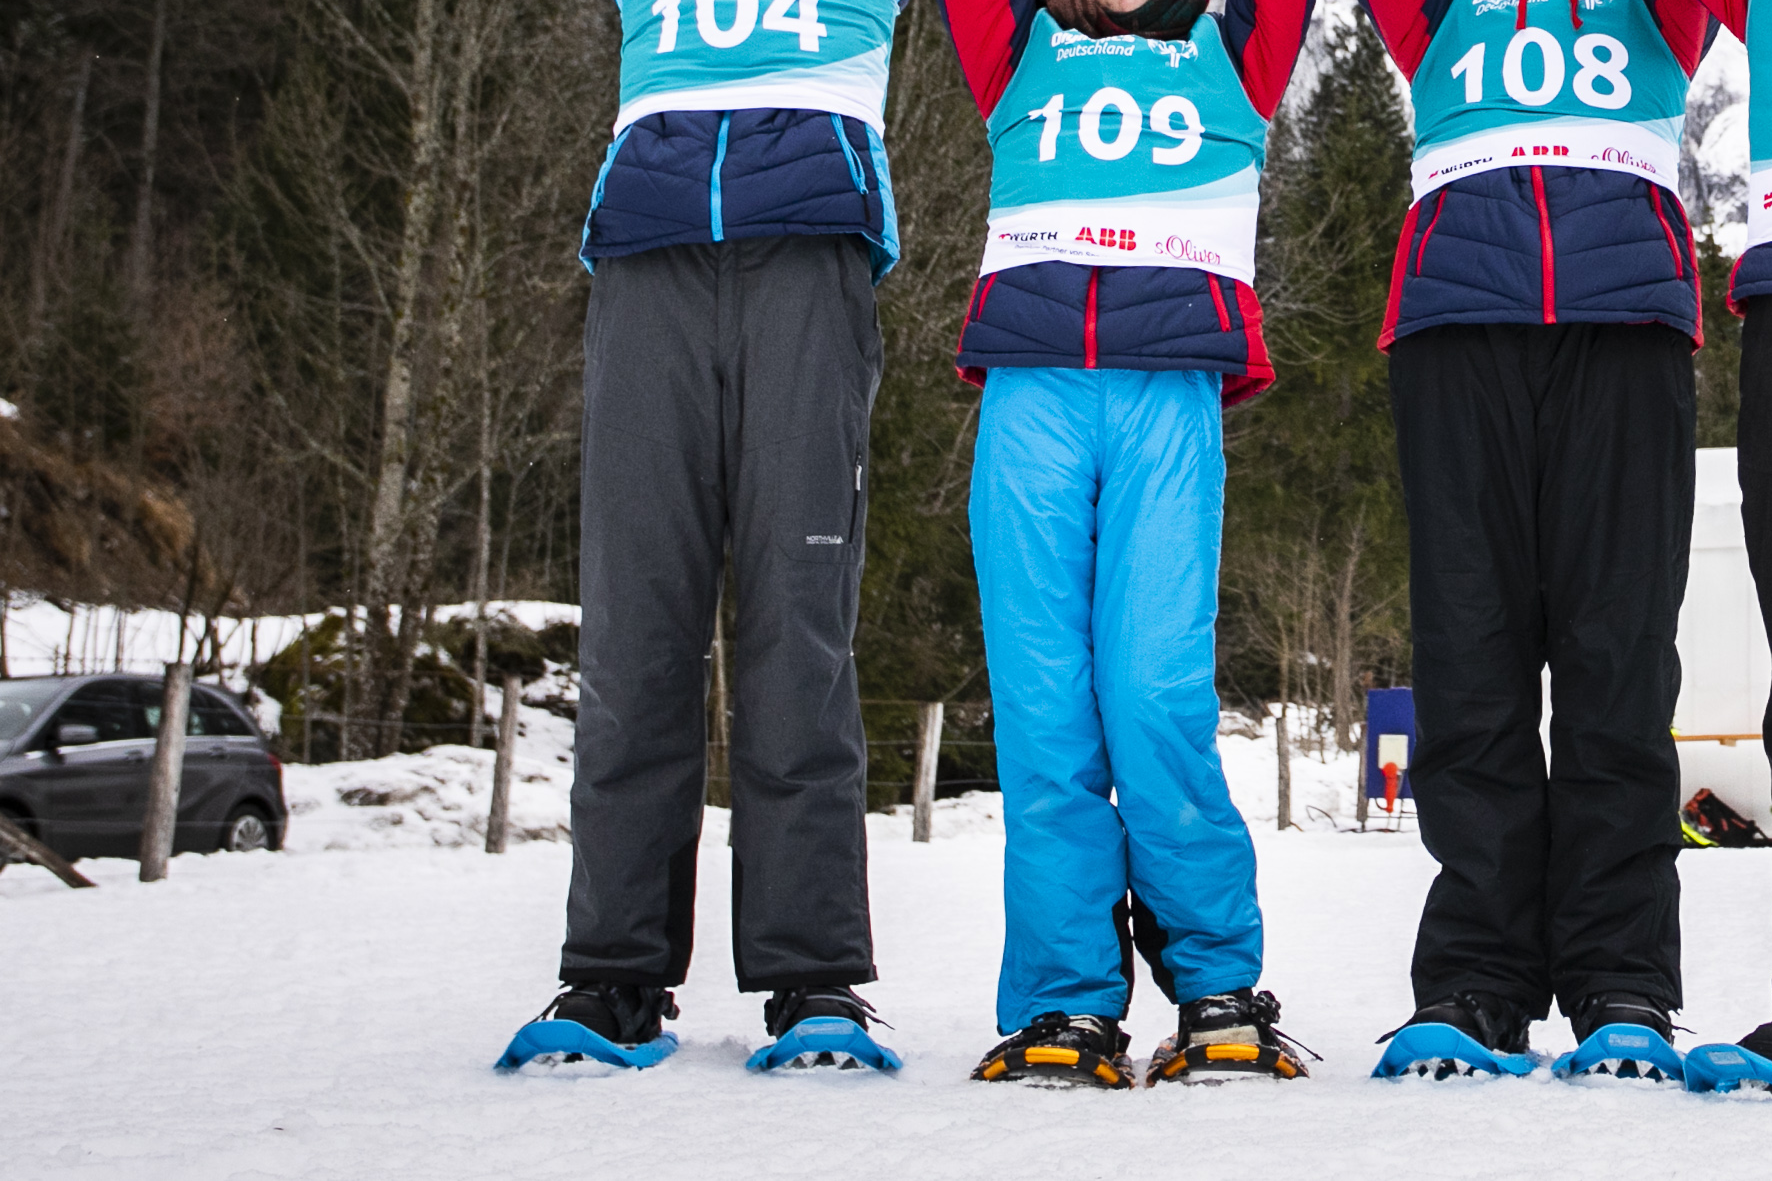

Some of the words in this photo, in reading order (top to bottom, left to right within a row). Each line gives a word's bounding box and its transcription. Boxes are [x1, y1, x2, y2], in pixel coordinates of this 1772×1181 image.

[1056, 40, 1136, 62] Deutschland
[1450, 27, 1632, 110] 108
[1027, 87, 1206, 166] 109
[1074, 226, 1137, 251] ABB
[1154, 234, 1221, 266] s.Oliver
